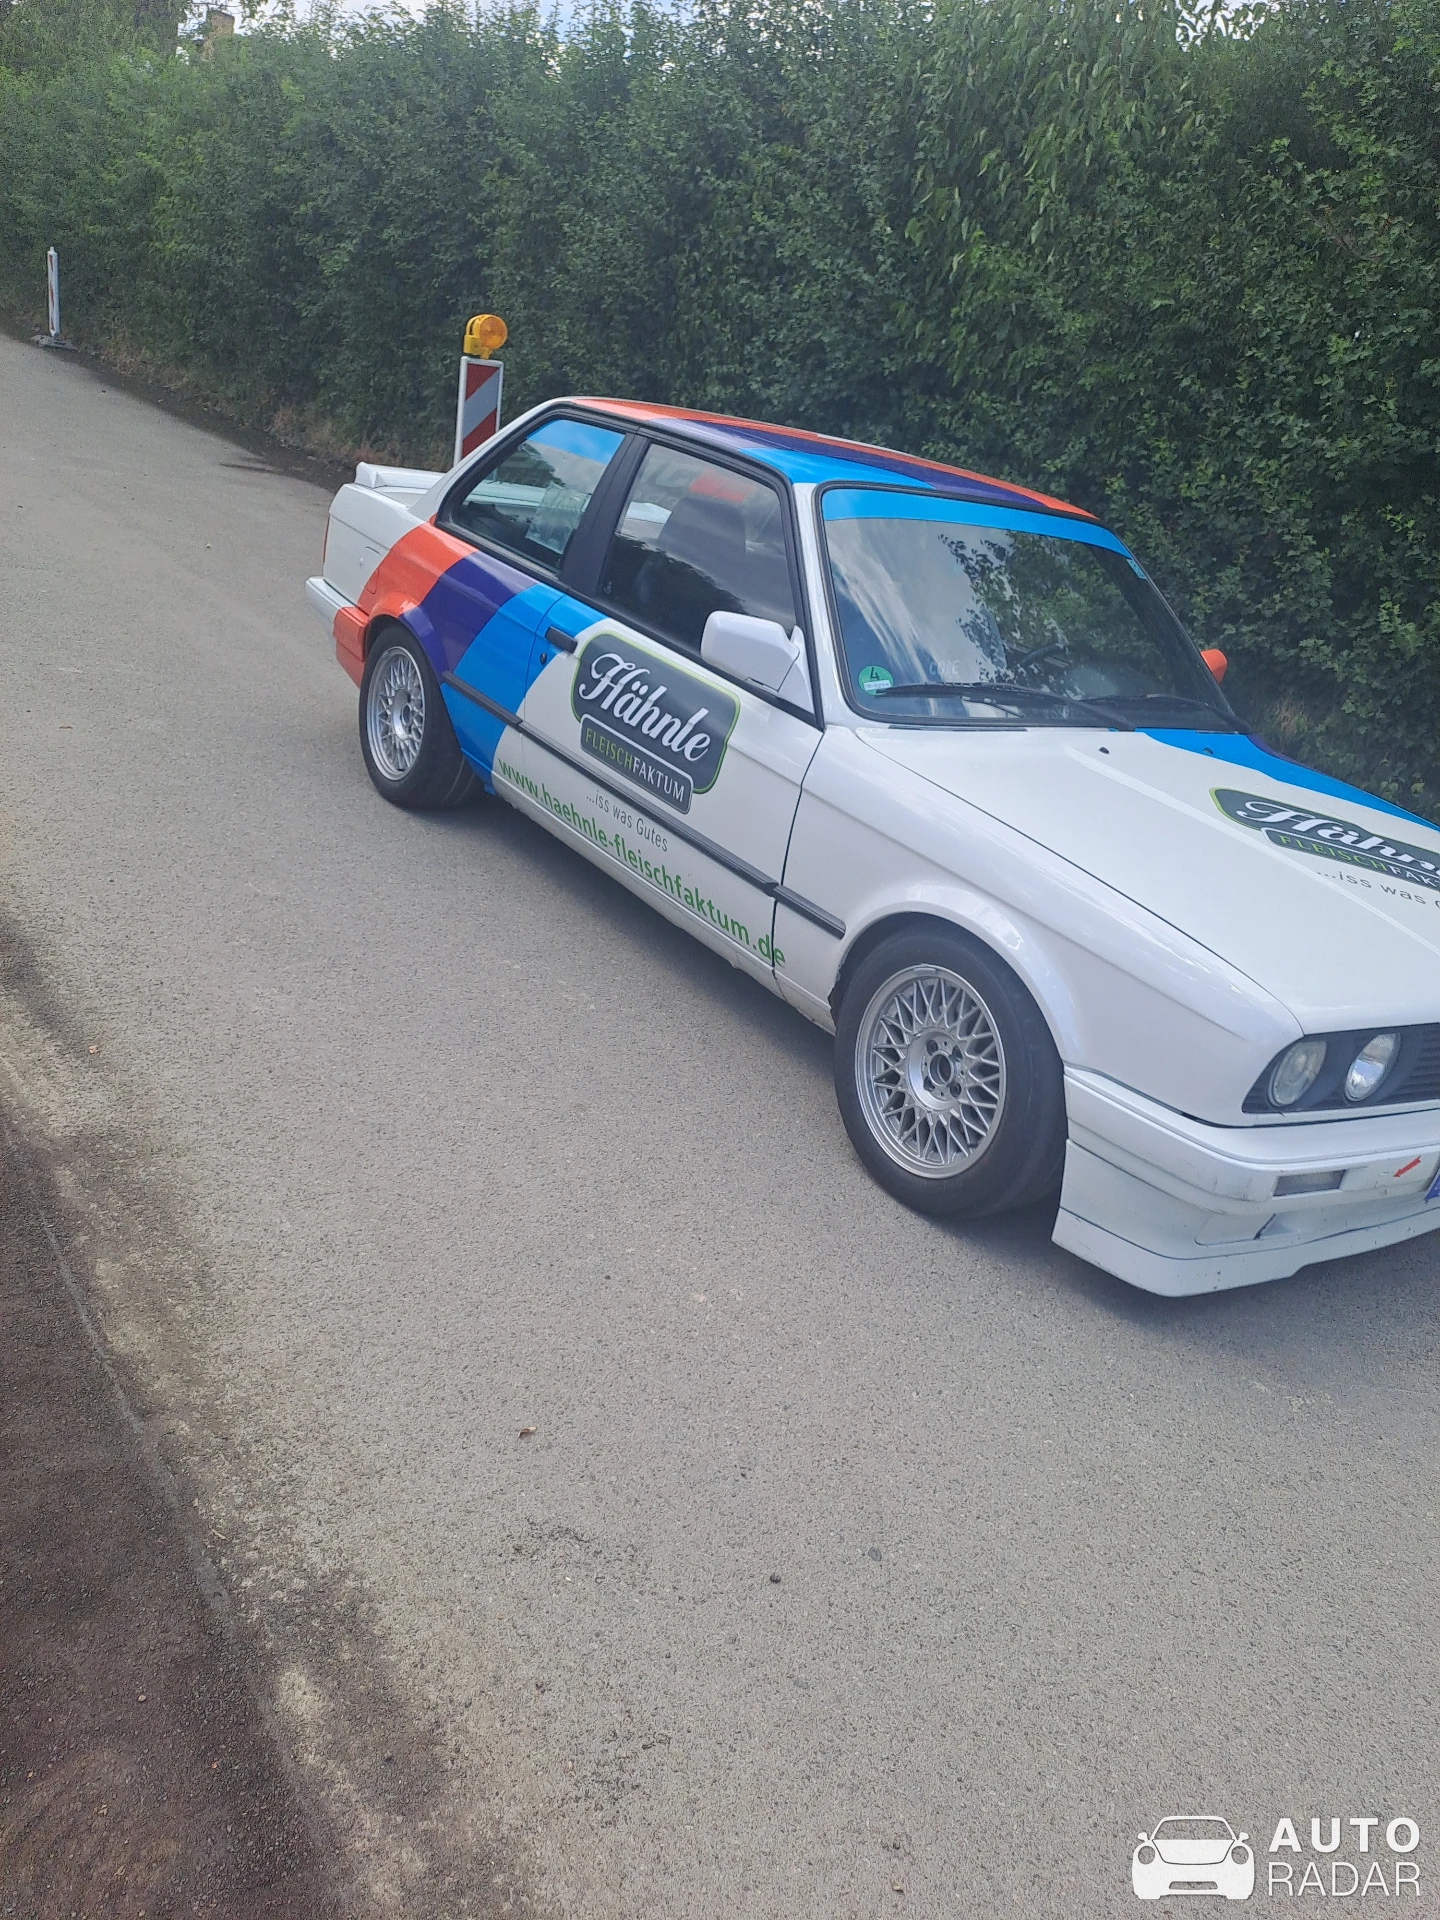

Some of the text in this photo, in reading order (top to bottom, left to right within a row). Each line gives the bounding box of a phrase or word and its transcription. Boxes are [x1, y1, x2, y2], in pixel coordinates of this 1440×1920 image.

[869, 667, 880, 680] 4
[578, 652, 711, 762] Hähnle
[585, 728, 685, 803] FLEISCHFAKTUM
[612, 804, 633, 829] was
[636, 817, 668, 852] Gutes
[497, 757, 786, 967] www.haehnle-fleischfaktum.de
[1380, 884, 1427, 905] was
